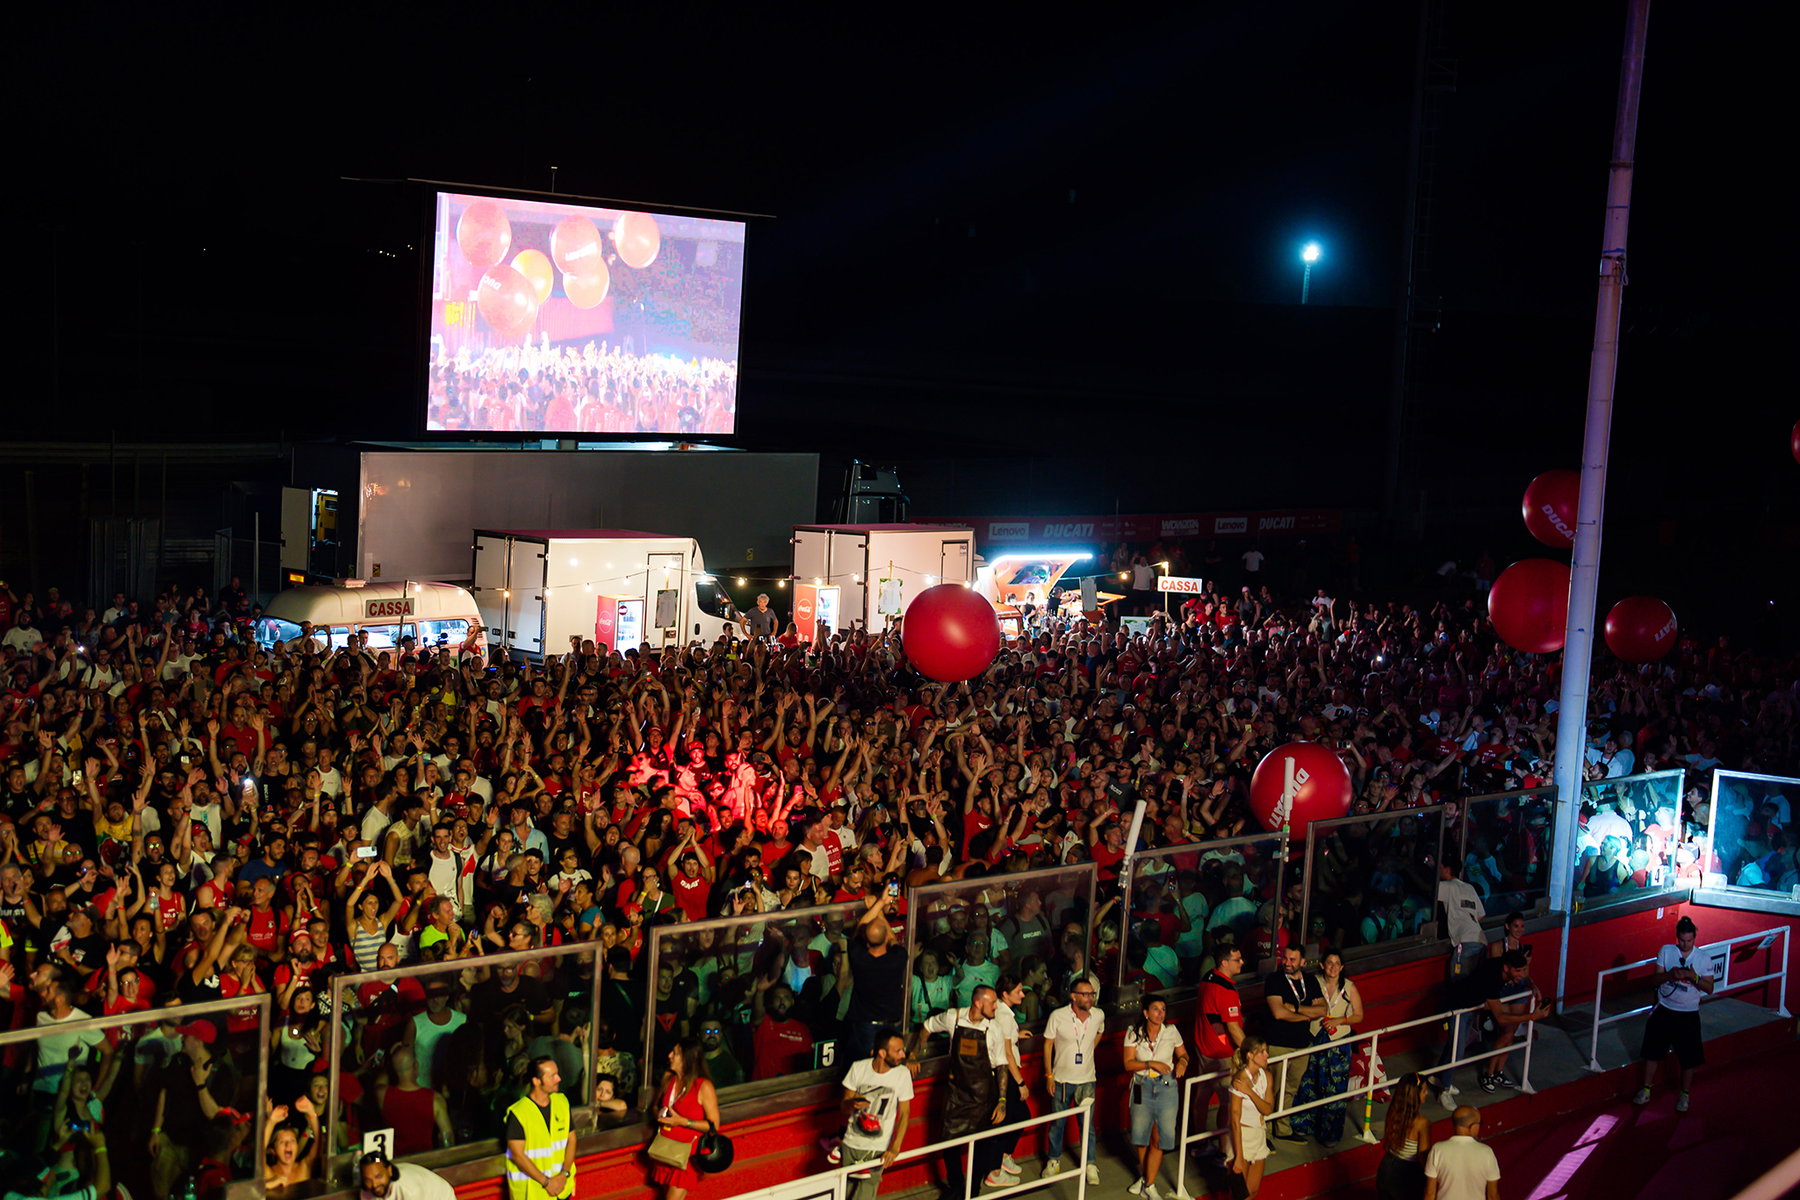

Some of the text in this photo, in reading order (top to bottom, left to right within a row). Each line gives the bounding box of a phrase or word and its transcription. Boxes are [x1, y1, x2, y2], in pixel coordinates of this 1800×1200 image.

[1218, 519, 1245, 529] Lenovo
[1258, 517, 1296, 530] DUCATI
[1542, 504, 1575, 540] DUCA
[991, 525, 1026, 537] Lenovo
[1042, 523, 1095, 538] DUCATI
[1161, 579, 1199, 592] CASSA
[368, 601, 411, 616] CASSA
[1268, 767, 1310, 829] DUATI
[822, 1041, 835, 1067] 5
[373, 1133, 387, 1154] 3
